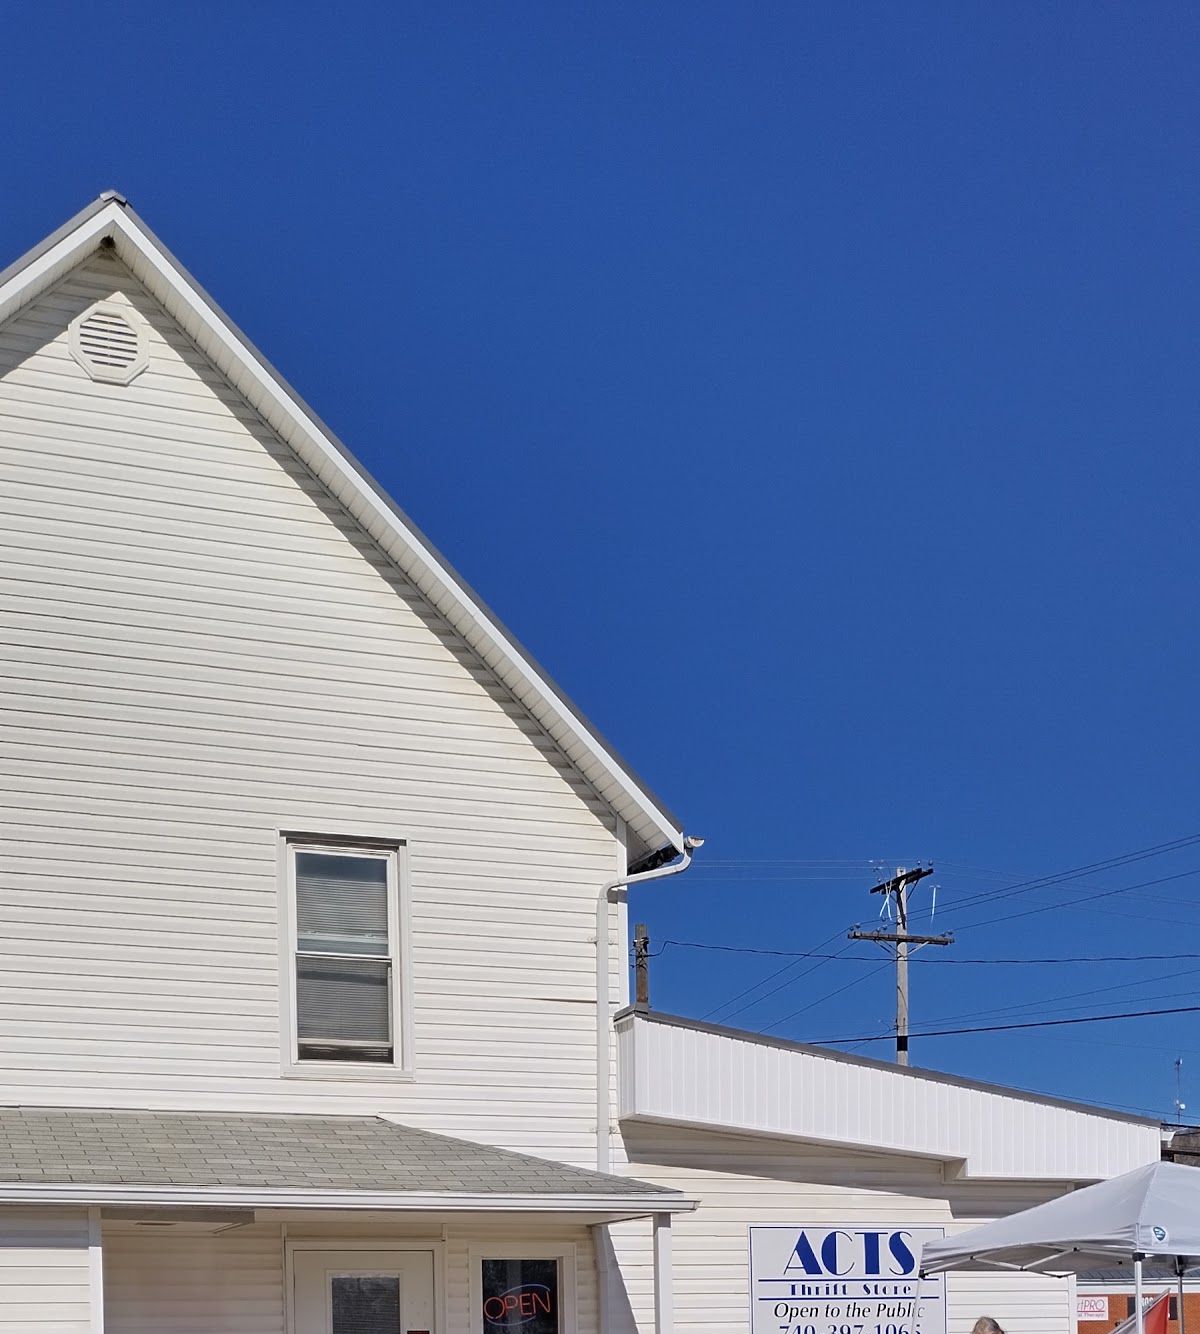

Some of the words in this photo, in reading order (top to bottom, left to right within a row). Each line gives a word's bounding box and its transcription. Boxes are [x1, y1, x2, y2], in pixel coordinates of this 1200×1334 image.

[783, 1230, 915, 1276] ACTS
[789, 1282, 848, 1296] Thrift
[862, 1282, 912, 1296] Store
[484, 1291, 551, 1320] OPEN
[773, 1302, 819, 1323] Open
[825, 1303, 841, 1318] to
[846, 1302, 871, 1318] the
